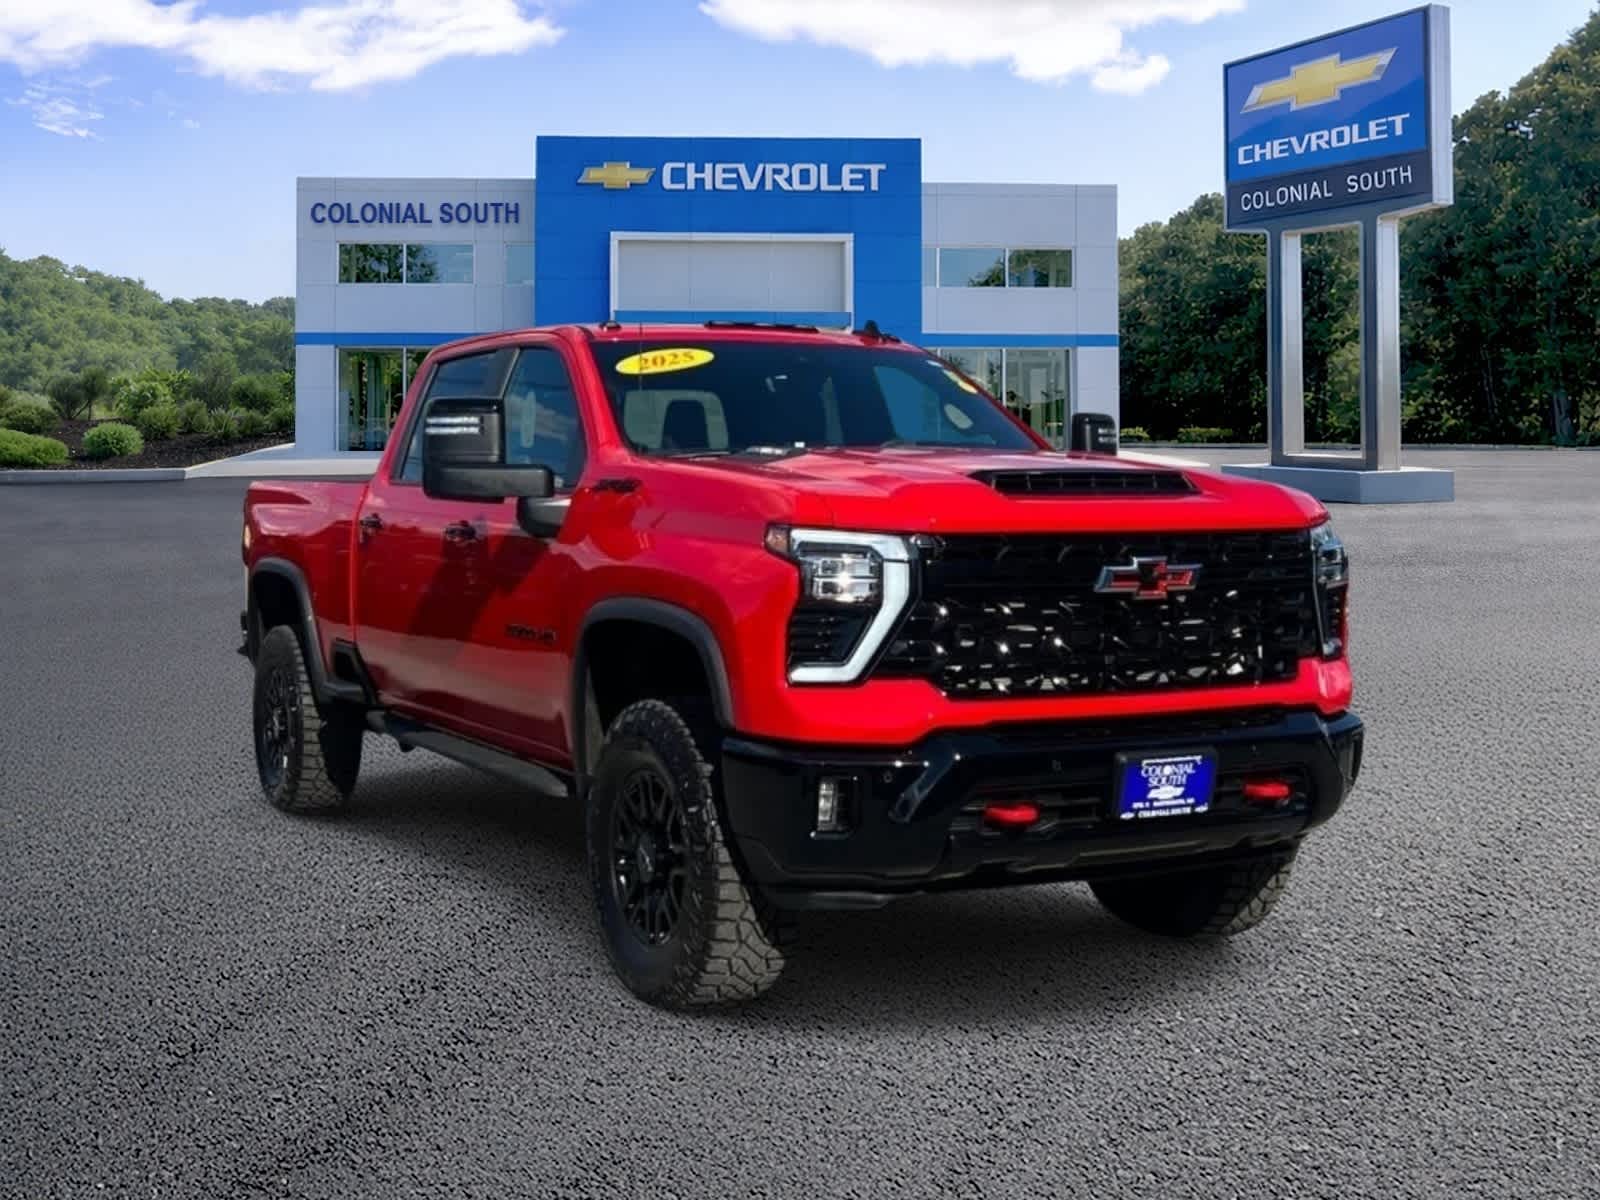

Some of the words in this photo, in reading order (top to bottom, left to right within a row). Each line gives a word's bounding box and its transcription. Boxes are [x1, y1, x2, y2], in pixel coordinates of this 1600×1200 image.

[1238, 113, 1410, 165] CHEVROLET
[661, 162, 886, 191] CHEVROLET
[1241, 180, 1333, 211] COLONIAL
[1346, 165, 1412, 193] SOUTH
[310, 202, 432, 224] COLONIAL
[439, 202, 521, 224] SOUTH
[639, 351, 695, 371] 2025
